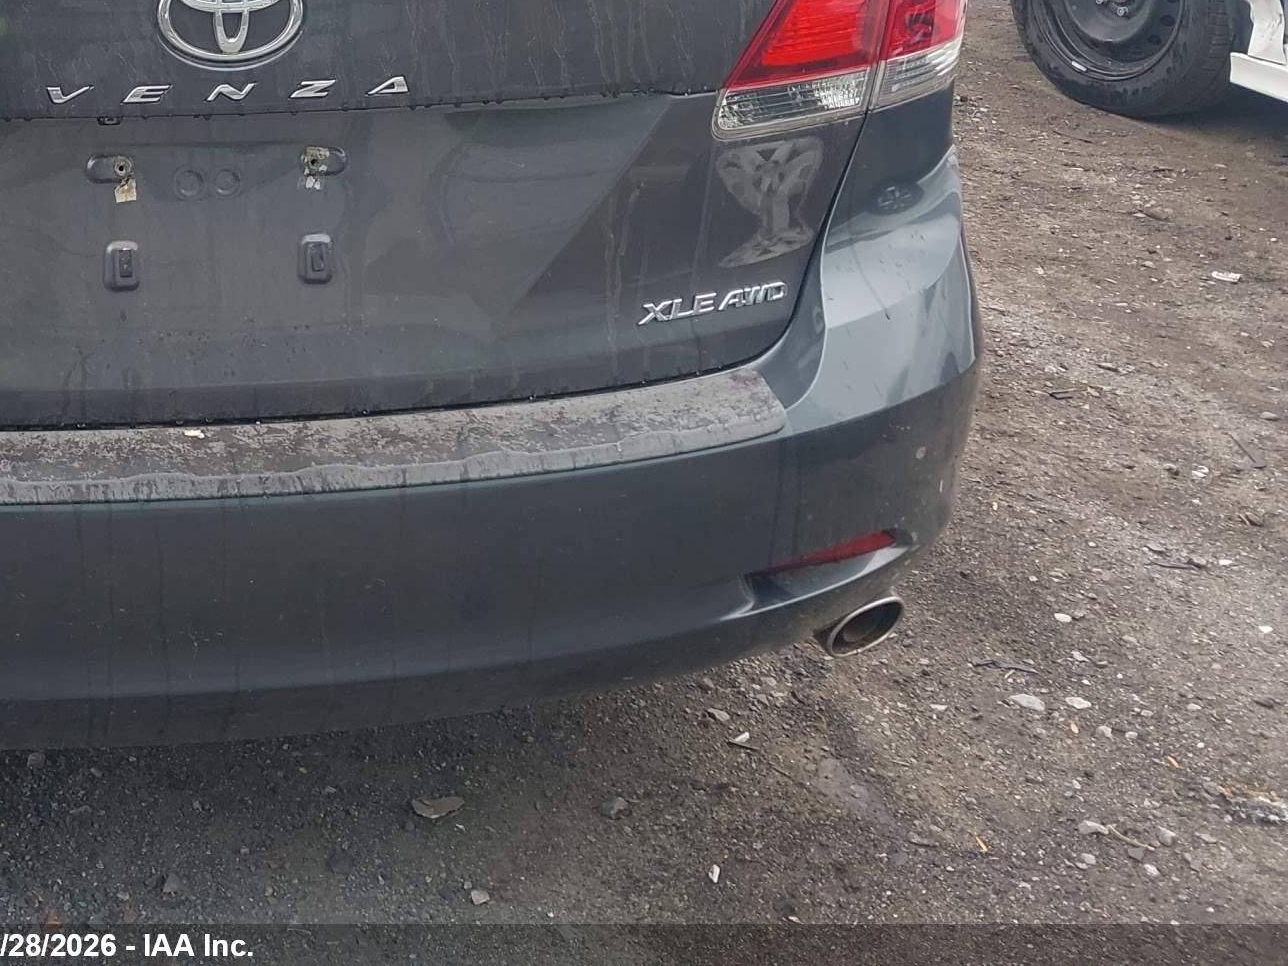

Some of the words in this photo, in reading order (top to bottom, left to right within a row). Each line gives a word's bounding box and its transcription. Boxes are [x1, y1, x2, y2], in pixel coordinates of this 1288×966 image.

[45, 76, 411, 105] VENZA
[637, 292, 717, 326] XLE
[718, 281, 788, 311] AWD
